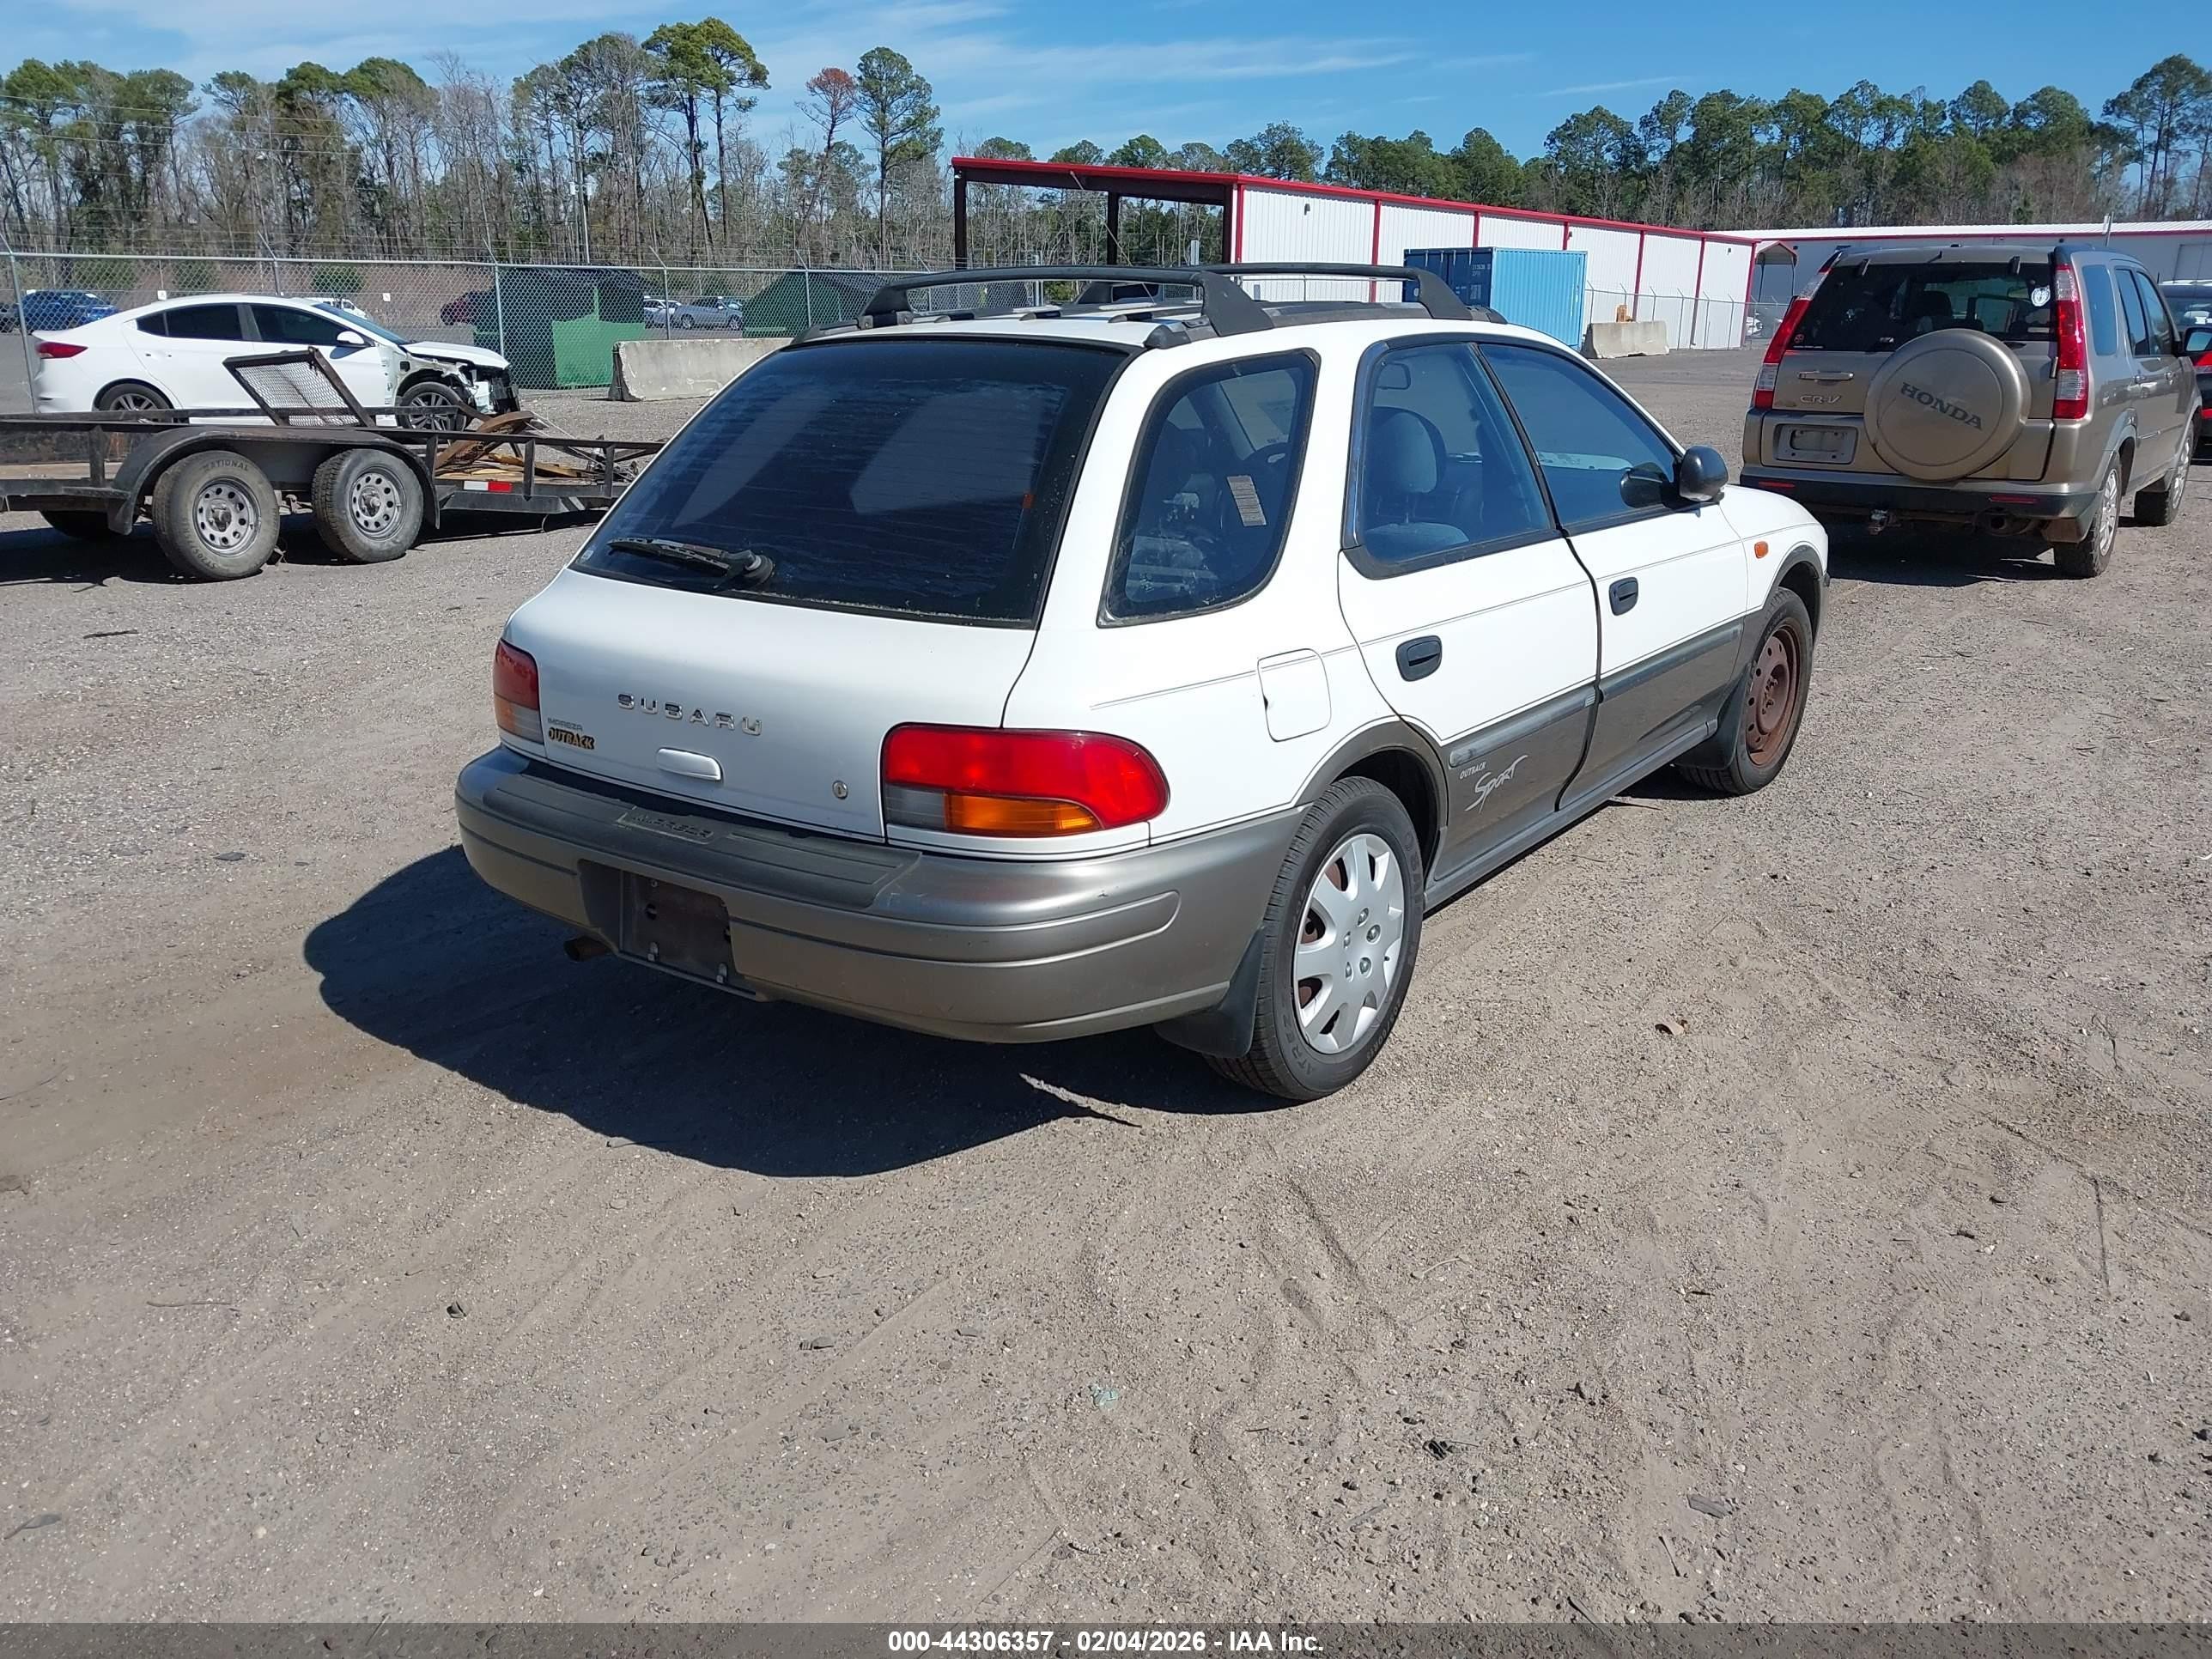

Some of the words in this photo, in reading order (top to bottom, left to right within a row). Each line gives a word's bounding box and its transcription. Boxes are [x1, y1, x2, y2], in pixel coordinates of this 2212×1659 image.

[1800, 394, 1842, 404] CR-V
[1900, 381, 1983, 431] HONDA
[617, 693, 763, 737] SUBARU
[549, 726, 595, 750] OUTBACK
[1460, 761, 1486, 779] OUTBACK
